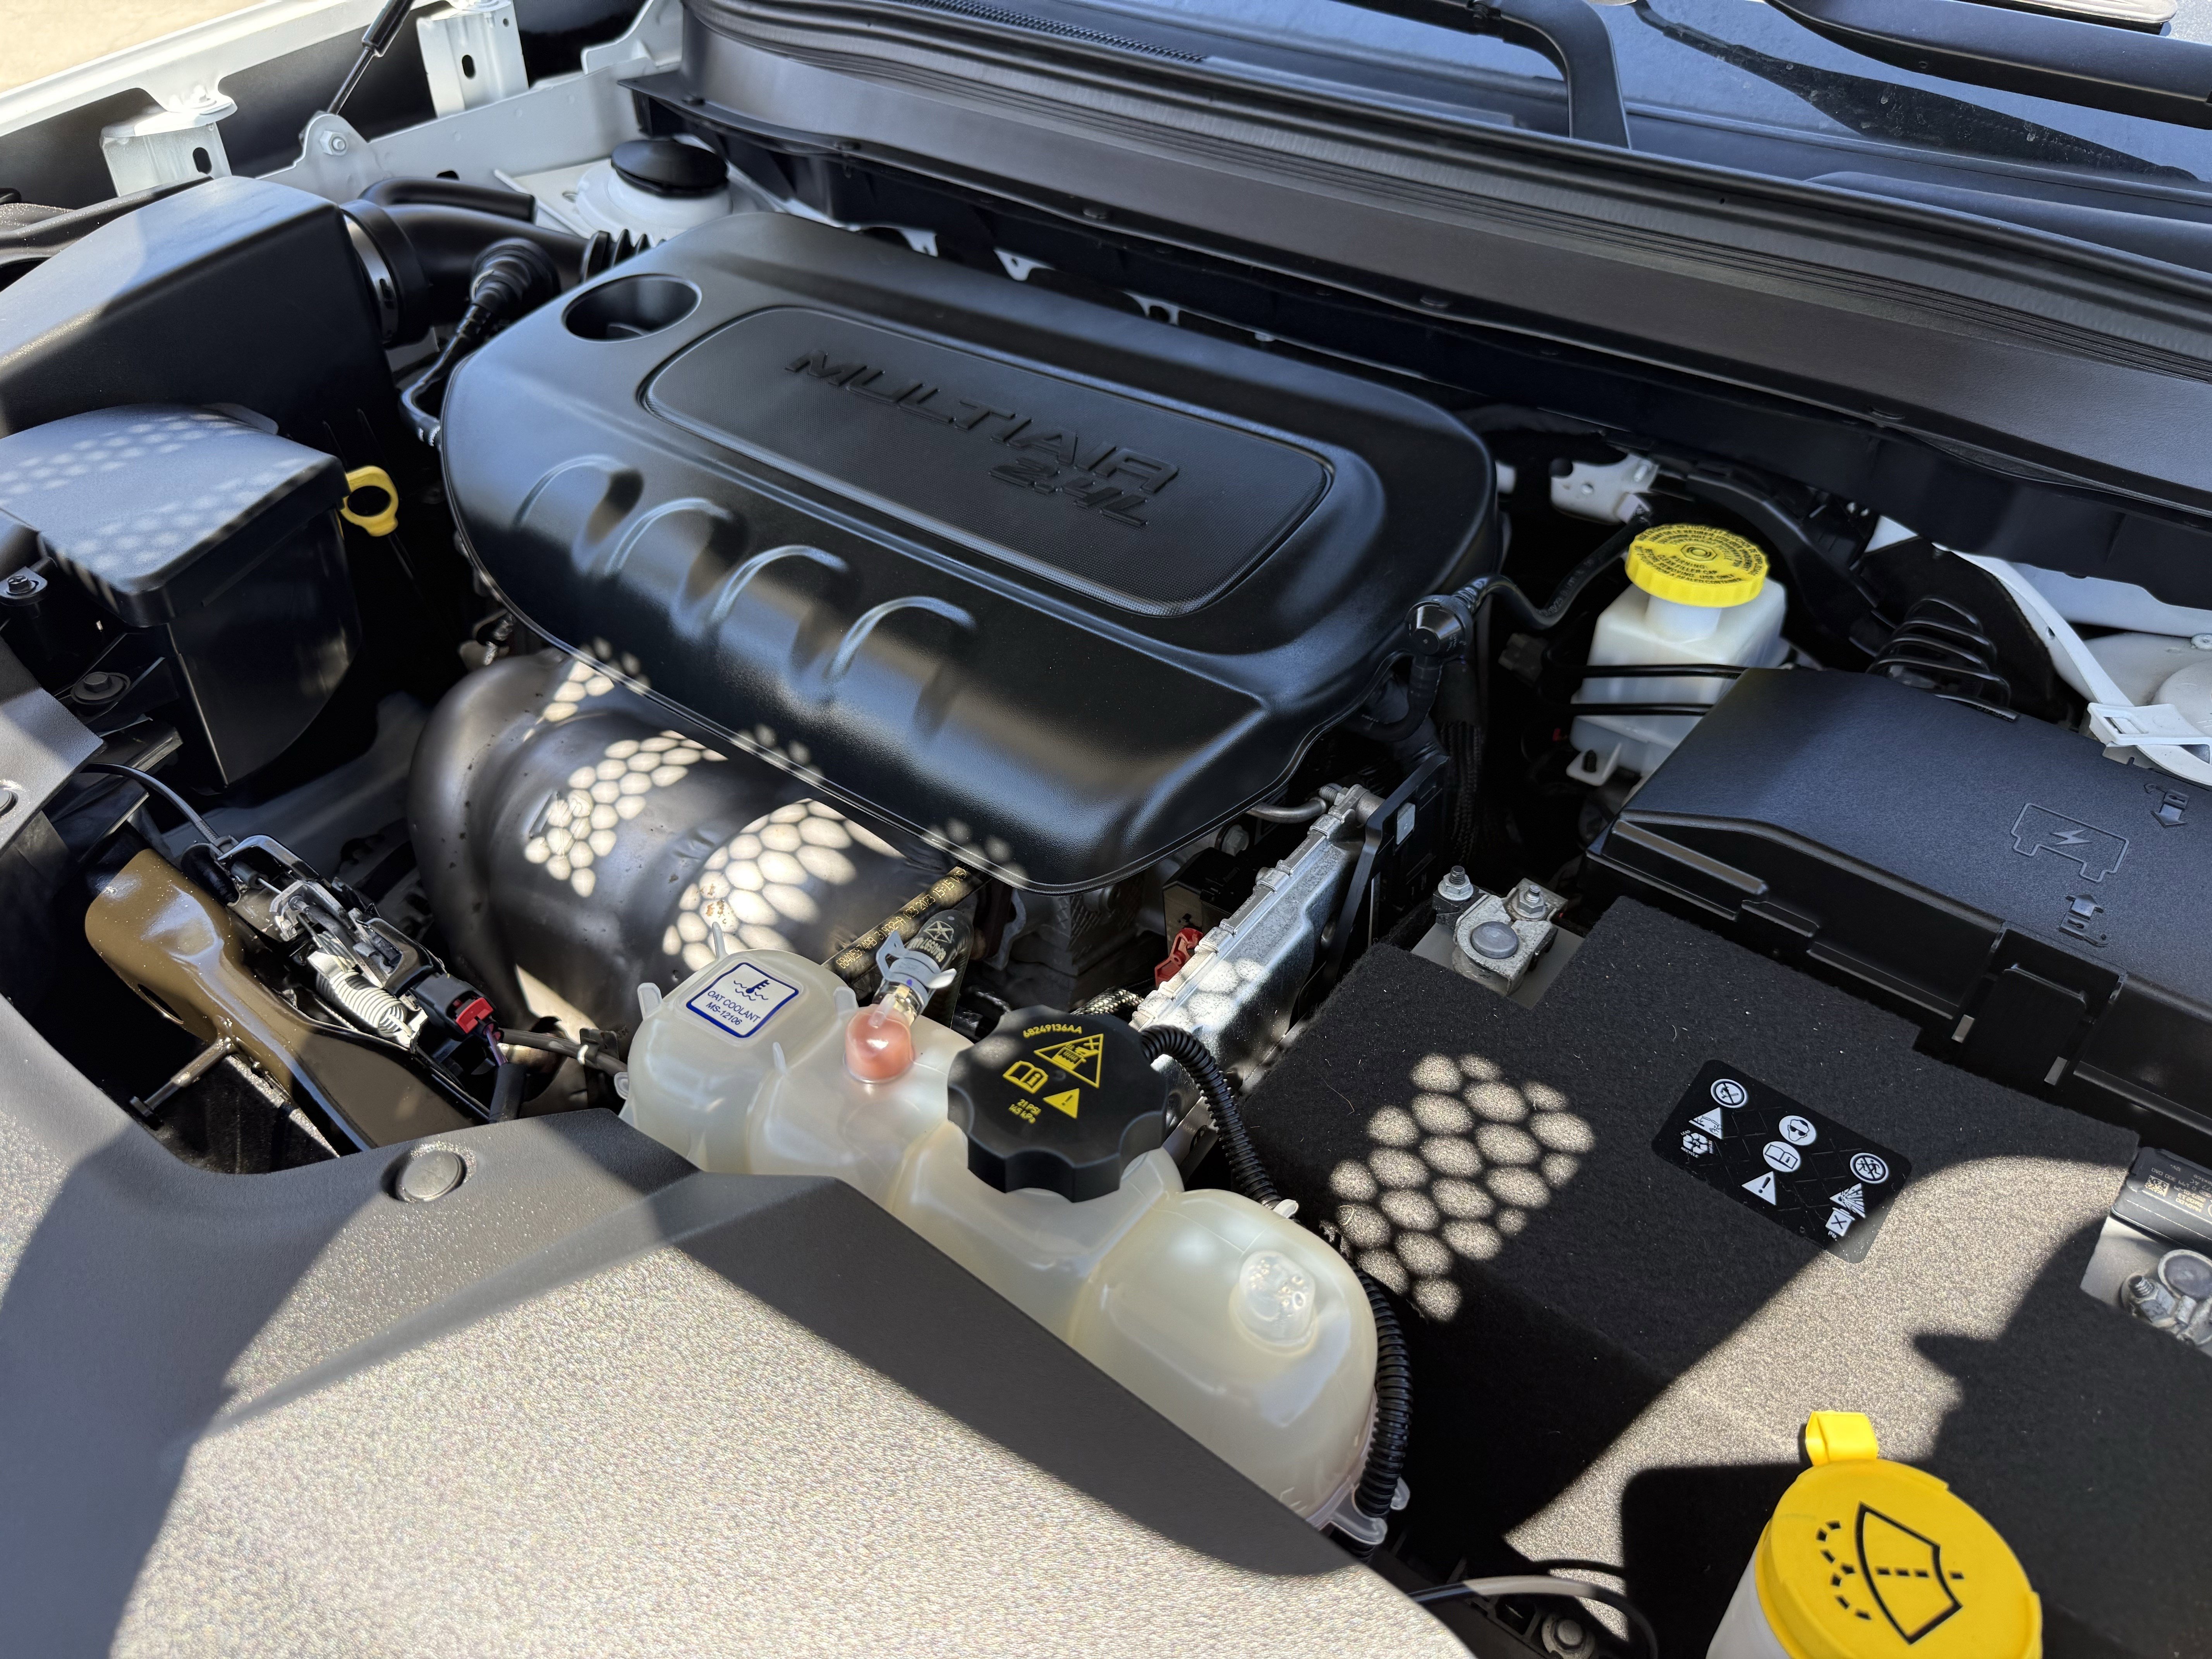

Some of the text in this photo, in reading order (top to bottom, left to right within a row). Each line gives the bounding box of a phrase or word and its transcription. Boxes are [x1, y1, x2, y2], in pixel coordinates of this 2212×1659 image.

[785, 350, 1178, 493] MULTIAIR
[989, 458, 1148, 527] 2.4L
[706, 1001, 743, 1025] MS-12106
[708, 991, 761, 1023] OAT COOLANT
[1023, 1024, 1082, 1039] 68249136AA
[1025, 1104, 1041, 1115] PSI
